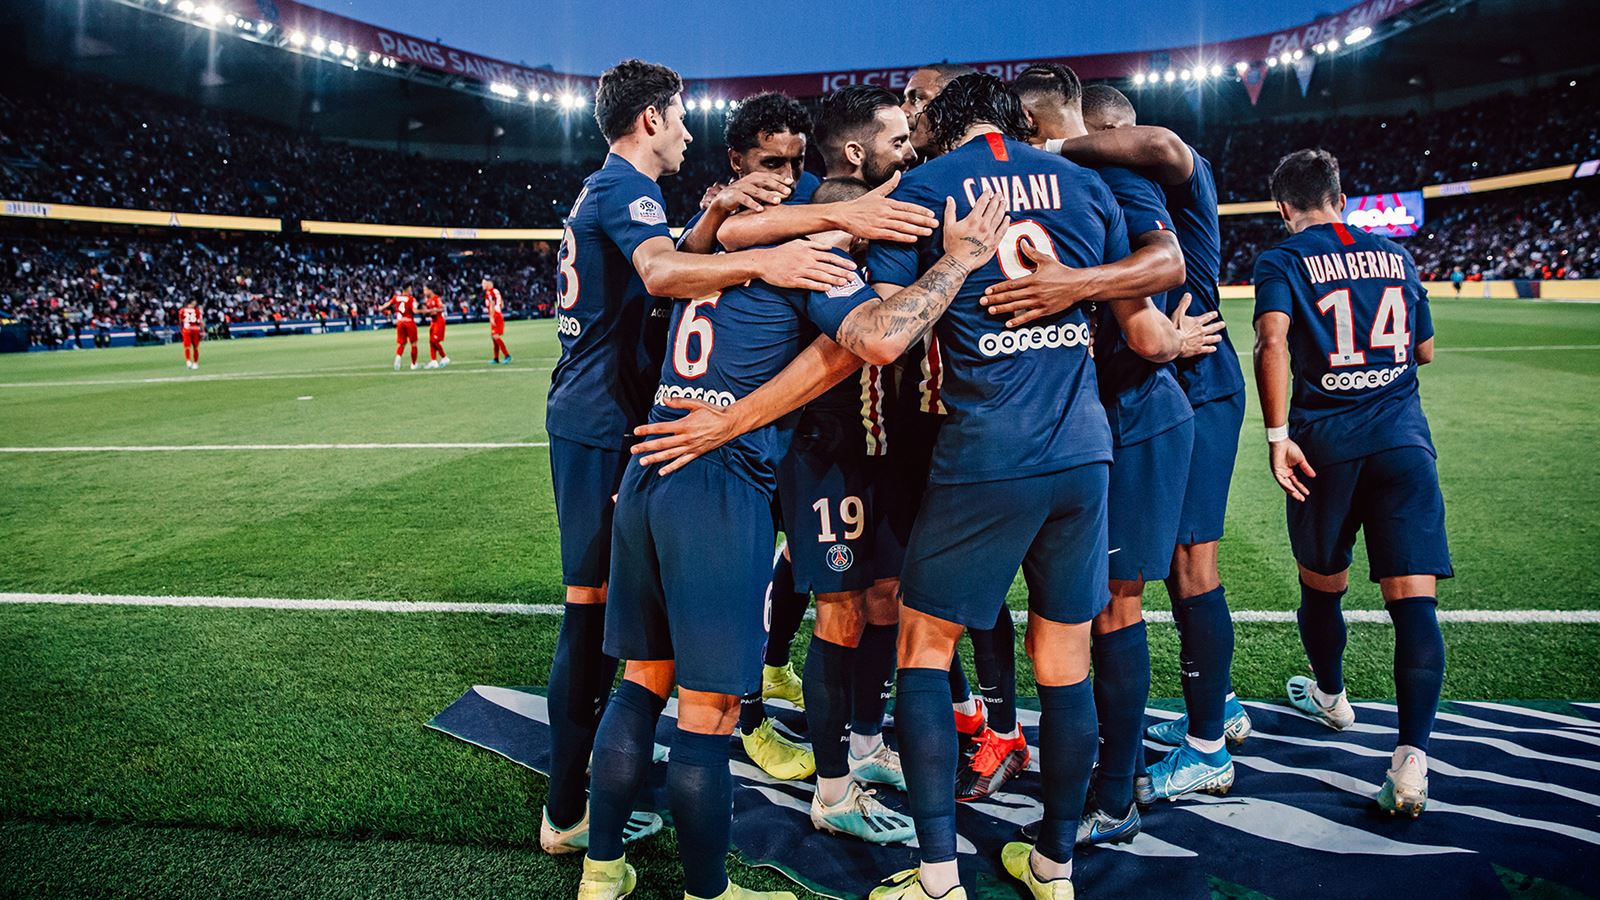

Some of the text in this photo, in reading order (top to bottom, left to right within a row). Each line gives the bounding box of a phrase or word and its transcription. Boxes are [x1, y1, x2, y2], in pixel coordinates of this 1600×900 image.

[378, 32, 446, 68] PARIS
[1267, 17, 1339, 54] PARIS
[963, 174, 1061, 212] CAVANI
[1304, 251, 1406, 284] JUAN BERNAT
[673, 290, 722, 379] 6
[979, 323, 1090, 356] ooredoo
[1315, 285, 1410, 368] 14
[812, 495, 865, 543] 19
